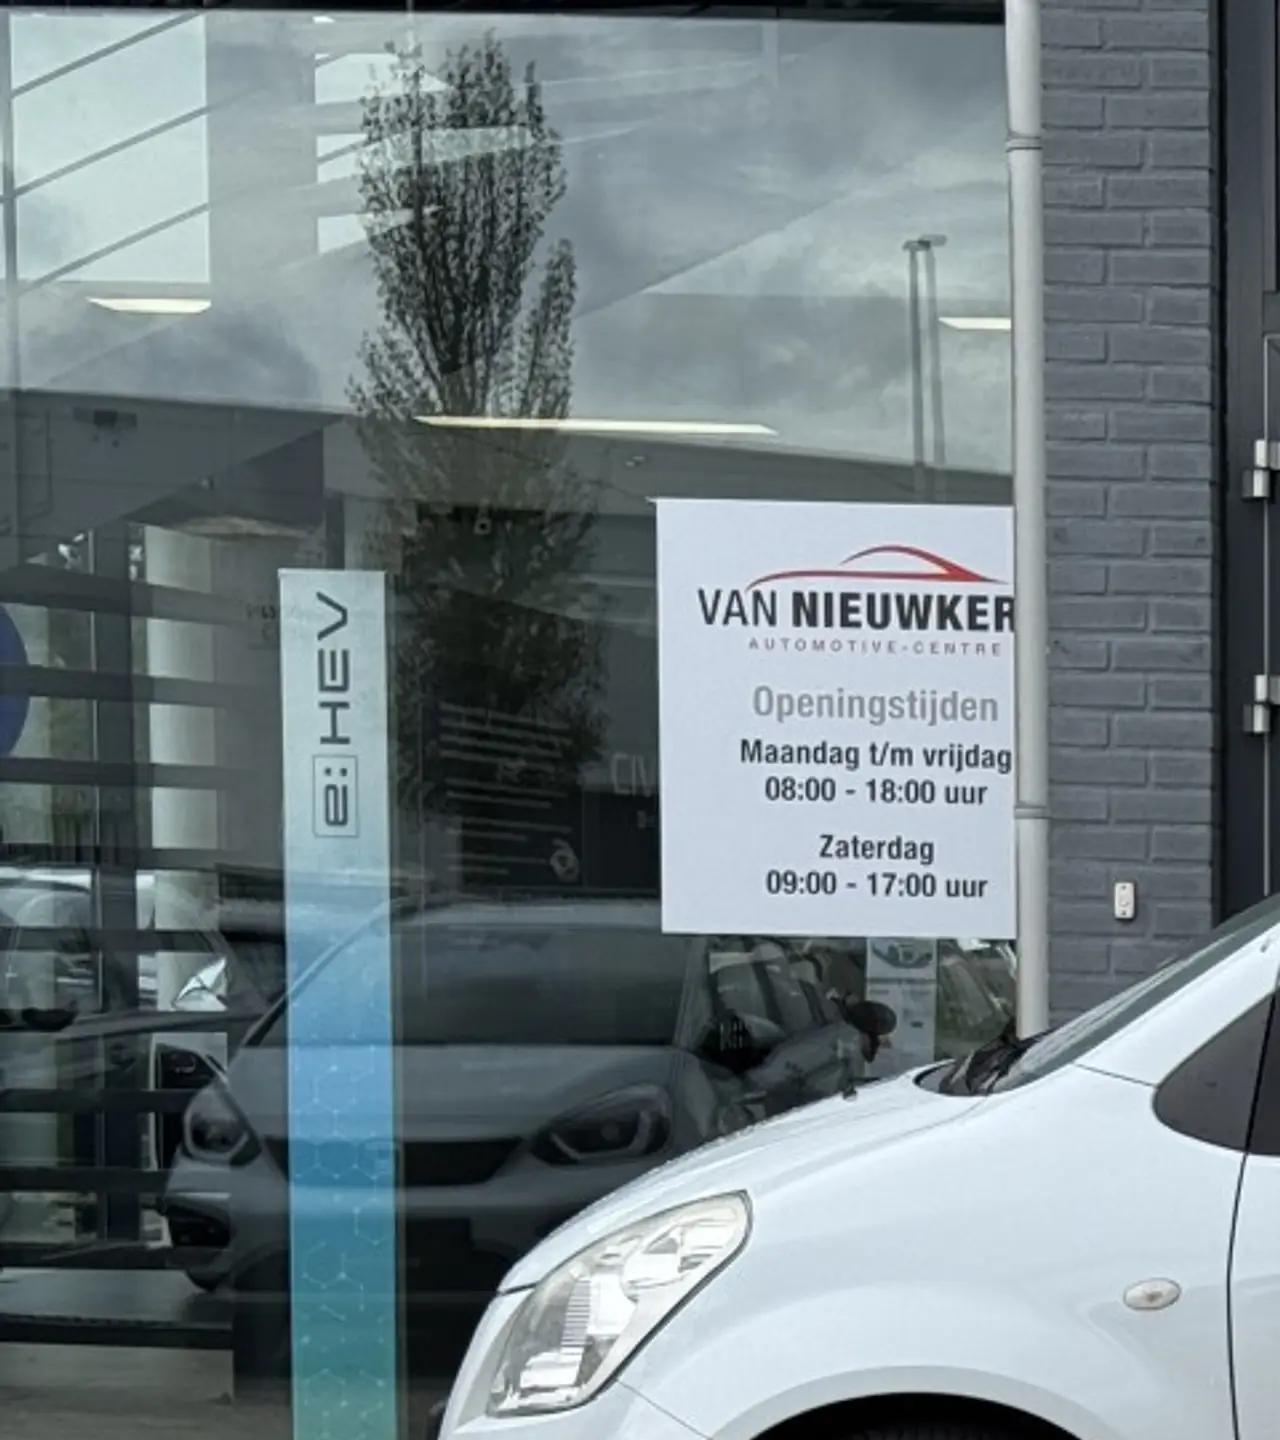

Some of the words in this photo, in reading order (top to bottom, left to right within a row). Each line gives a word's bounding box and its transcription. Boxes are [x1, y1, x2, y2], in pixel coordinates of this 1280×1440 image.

[698, 588, 777, 627] VAN
[753, 685, 999, 727] Openingstijden
[740, 739, 860, 772] Maandag
[869, 741, 914, 767] t/m
[924, 743, 1012, 774] vrijdag
[765, 776, 836, 802] 08:00
[867, 778, 936, 804] 18:00
[944, 785, 989, 805] uur
[819, 834, 935, 865] Zaterdag
[766, 869, 837, 895] 09:00
[867, 872, 937, 898] 17:00
[945, 878, 989, 898] uur
